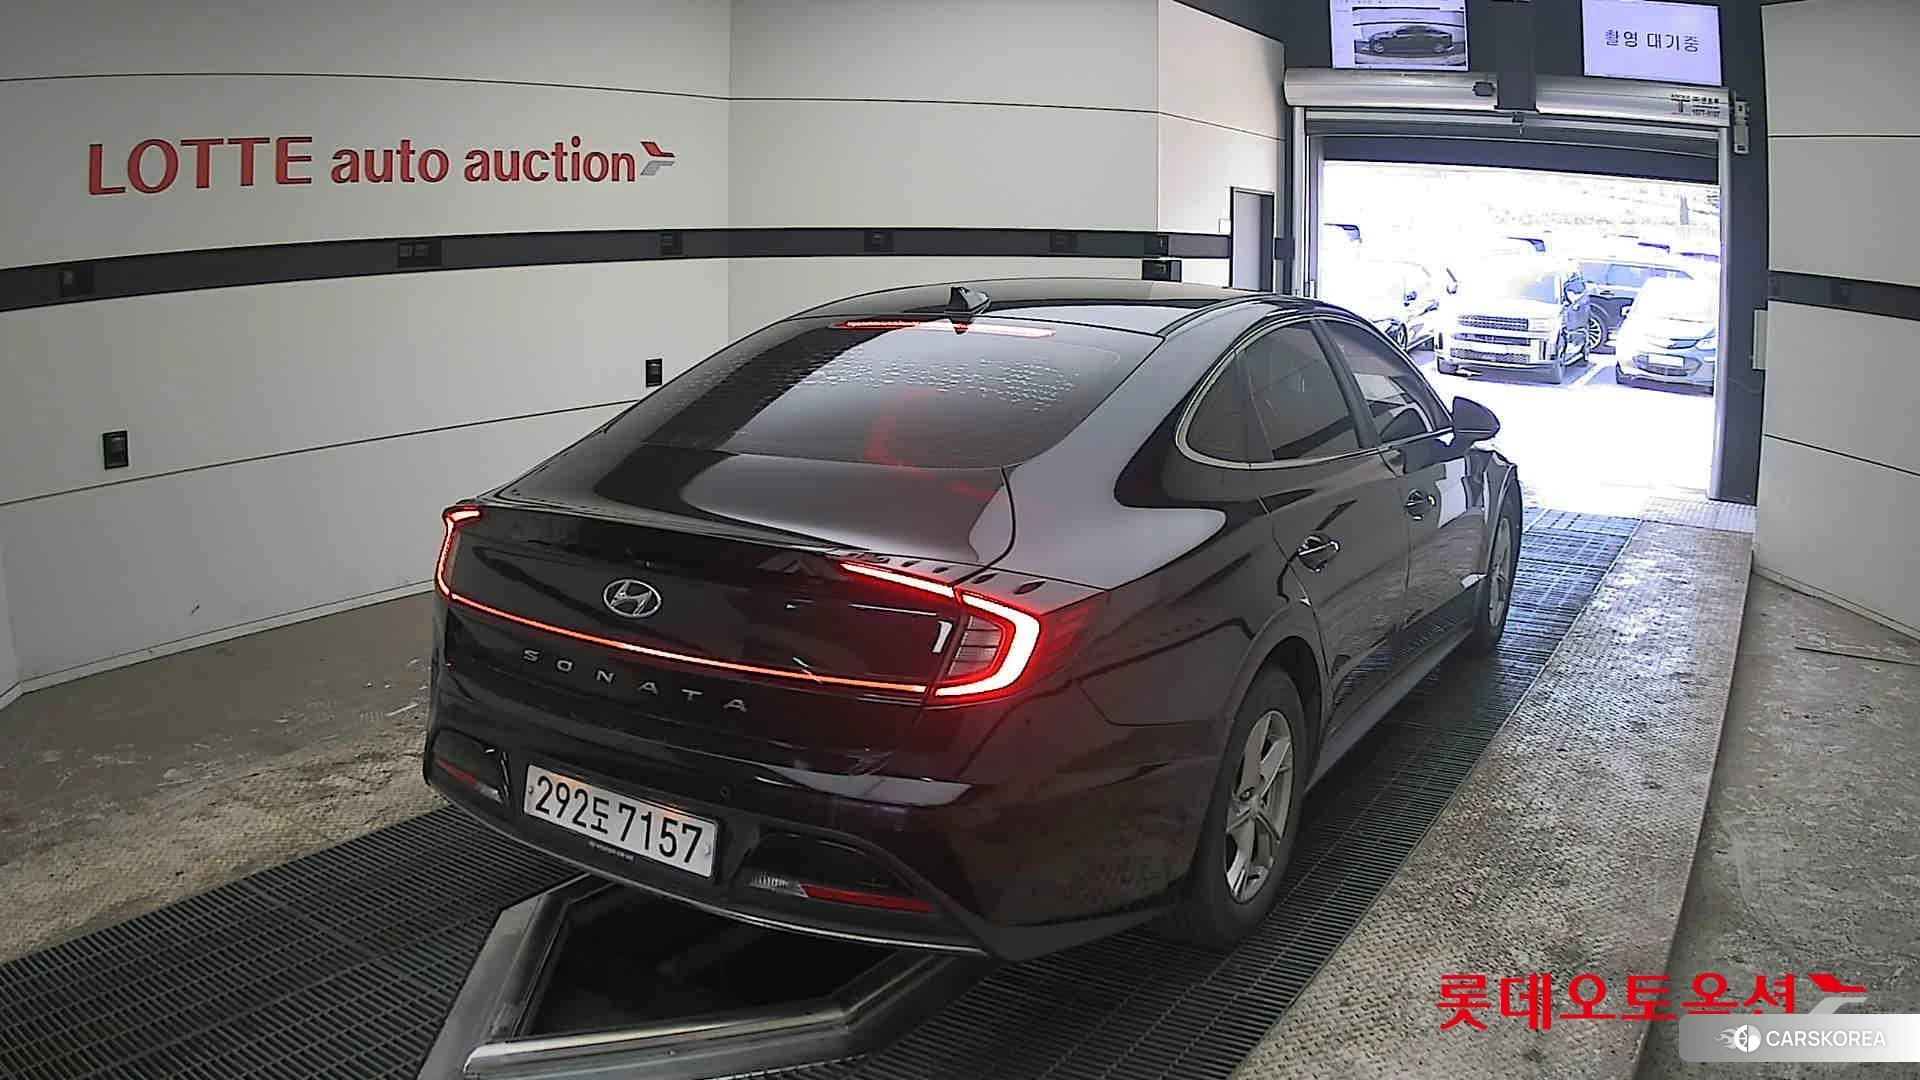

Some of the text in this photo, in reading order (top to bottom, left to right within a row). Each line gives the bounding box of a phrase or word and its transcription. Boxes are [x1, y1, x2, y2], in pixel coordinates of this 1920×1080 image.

[1646, 32, 1701, 53] 대기중
[88, 135, 636, 195] LOTTE auto auction
[522, 649, 748, 713] SONATA
